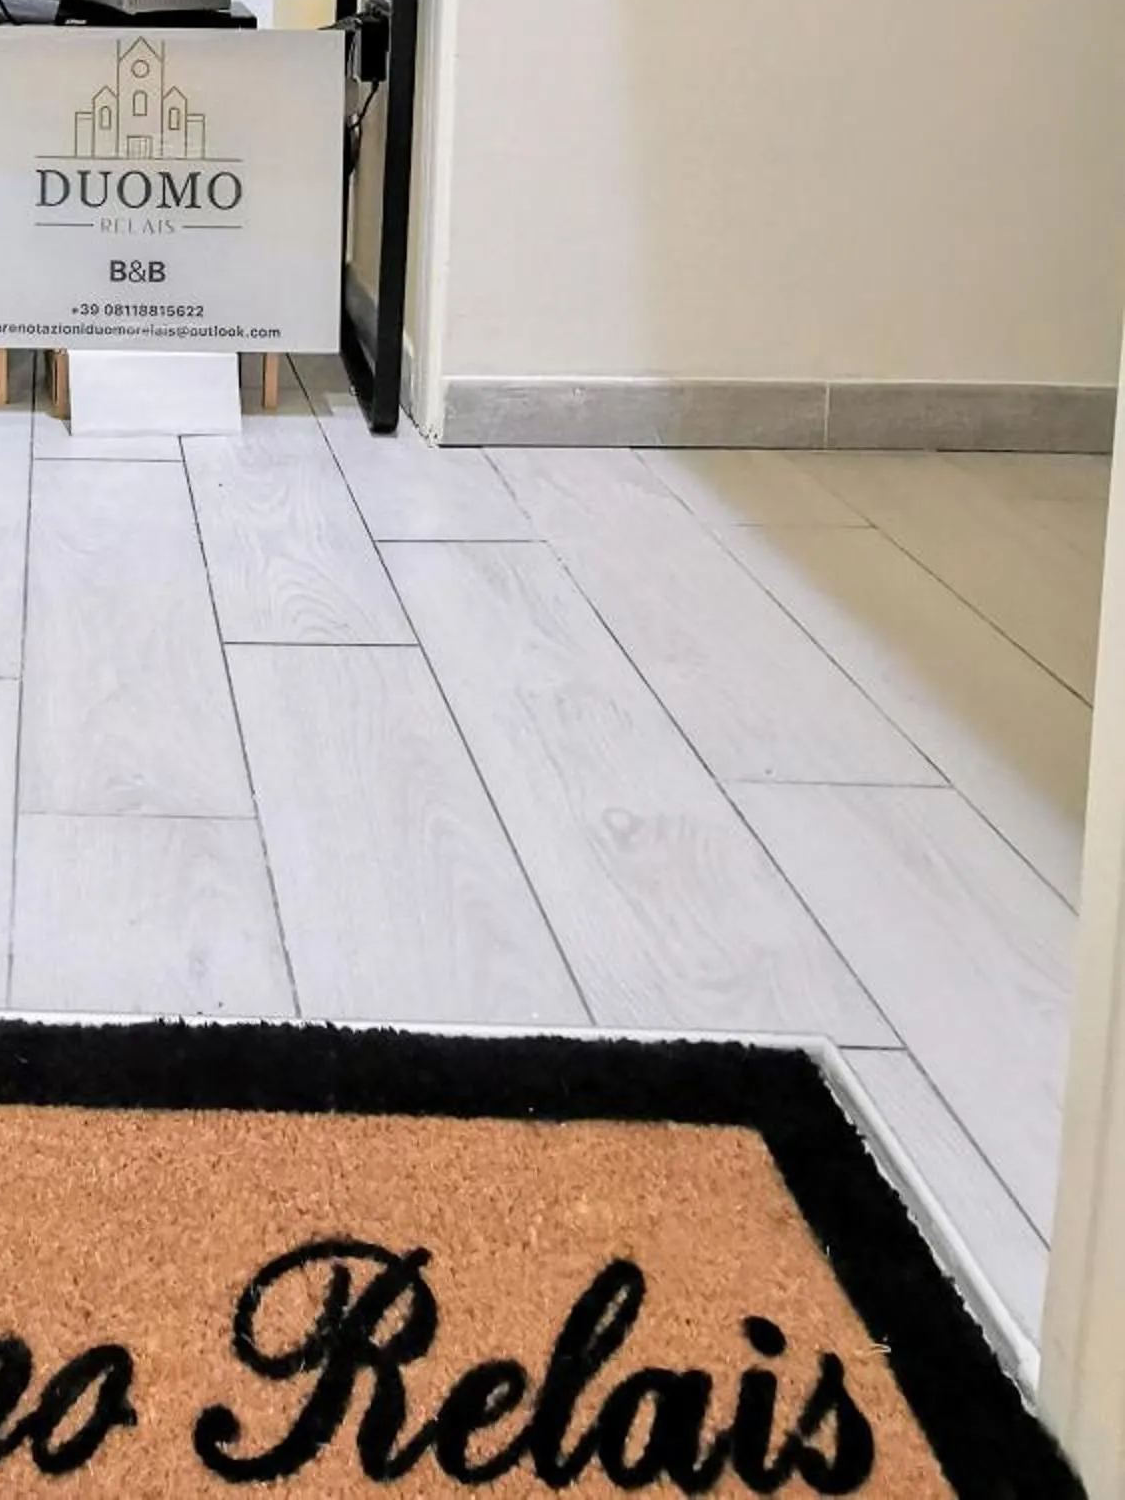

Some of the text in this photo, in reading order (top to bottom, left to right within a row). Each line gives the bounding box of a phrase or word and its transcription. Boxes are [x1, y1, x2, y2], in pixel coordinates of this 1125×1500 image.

[35, 169, 243, 210] DUOMO
[110, 259, 166, 283] B&B
[71, 303, 204, 318] +39 08118815622
[192, 1238, 875, 1496] Relais
